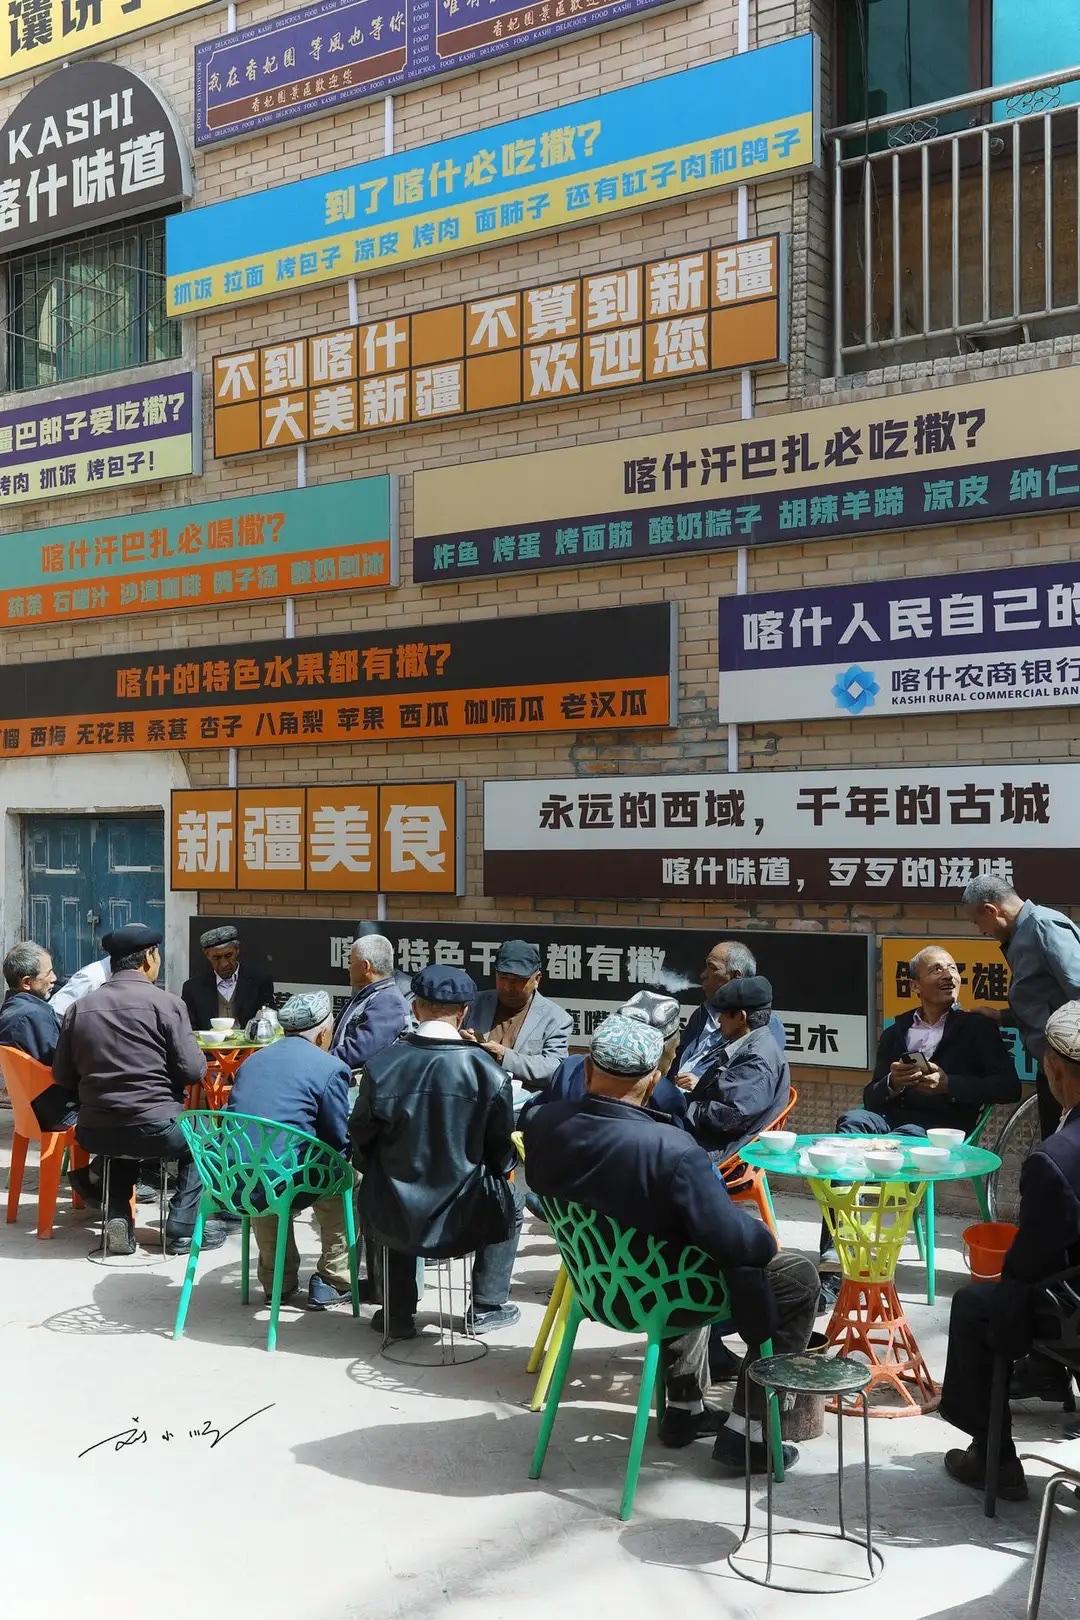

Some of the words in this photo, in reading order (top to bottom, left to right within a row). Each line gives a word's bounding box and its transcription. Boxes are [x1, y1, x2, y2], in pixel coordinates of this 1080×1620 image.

[592, 11, 608, 20] FOOD
[9, 88, 134, 165] KASHI
[173, 277, 213, 306] 抓饭
[224, 264, 265, 294] 拉面
[275, 246, 341, 282] 烤包子
[354, 231, 399, 264] 凉皮
[412, 216, 460, 249] 烤肉
[475, 193, 550, 234] 面肺子
[565, 128, 801, 212] 还有缸子肉和鸽子
[217, 320, 407, 401] 不到喀什
[470, 240, 773, 349] 不算到新疆
[265, 364, 462, 446] 大美新疆
[530, 315, 709, 397] 欢迎您
[40, 463, 77, 490] 抓饭
[623, 408, 986, 495] 喀什汗巴扎必吃撒?
[433, 541, 480, 571] 炸鱼
[492, 532, 541, 563] 烤蛋
[555, 521, 633, 556] 烤面筋
[648, 504, 762, 546] 酸奶粽子
[779, 486, 905, 530] 胡辣羊蹄
[923, 474, 989, 512] 凉皮
[1009, 464, 1080, 501] 纳仁
[742, 582, 1080, 651] 喀什人民自己的
[116, 641, 452, 698] 喀什的特色水果都有撒?
[891, 656, 1080, 693] 喀什农商银行
[892, 697, 926, 705] KASHI
[929, 693, 966, 703] RURAL
[969, 687, 1050, 701] COMMERCIAL
[77, 721, 135, 745] 无花果
[200, 714, 243, 739] 杏子
[255, 709, 324, 737] 八角梨
[337, 706, 385, 731] 苹果
[399, 701, 449, 728] 西瓜
[464, 695, 544, 725] 伽师瓜
[560, 689, 647, 719] 老汉瓜
[177, 804, 448, 873] 新疆美食
